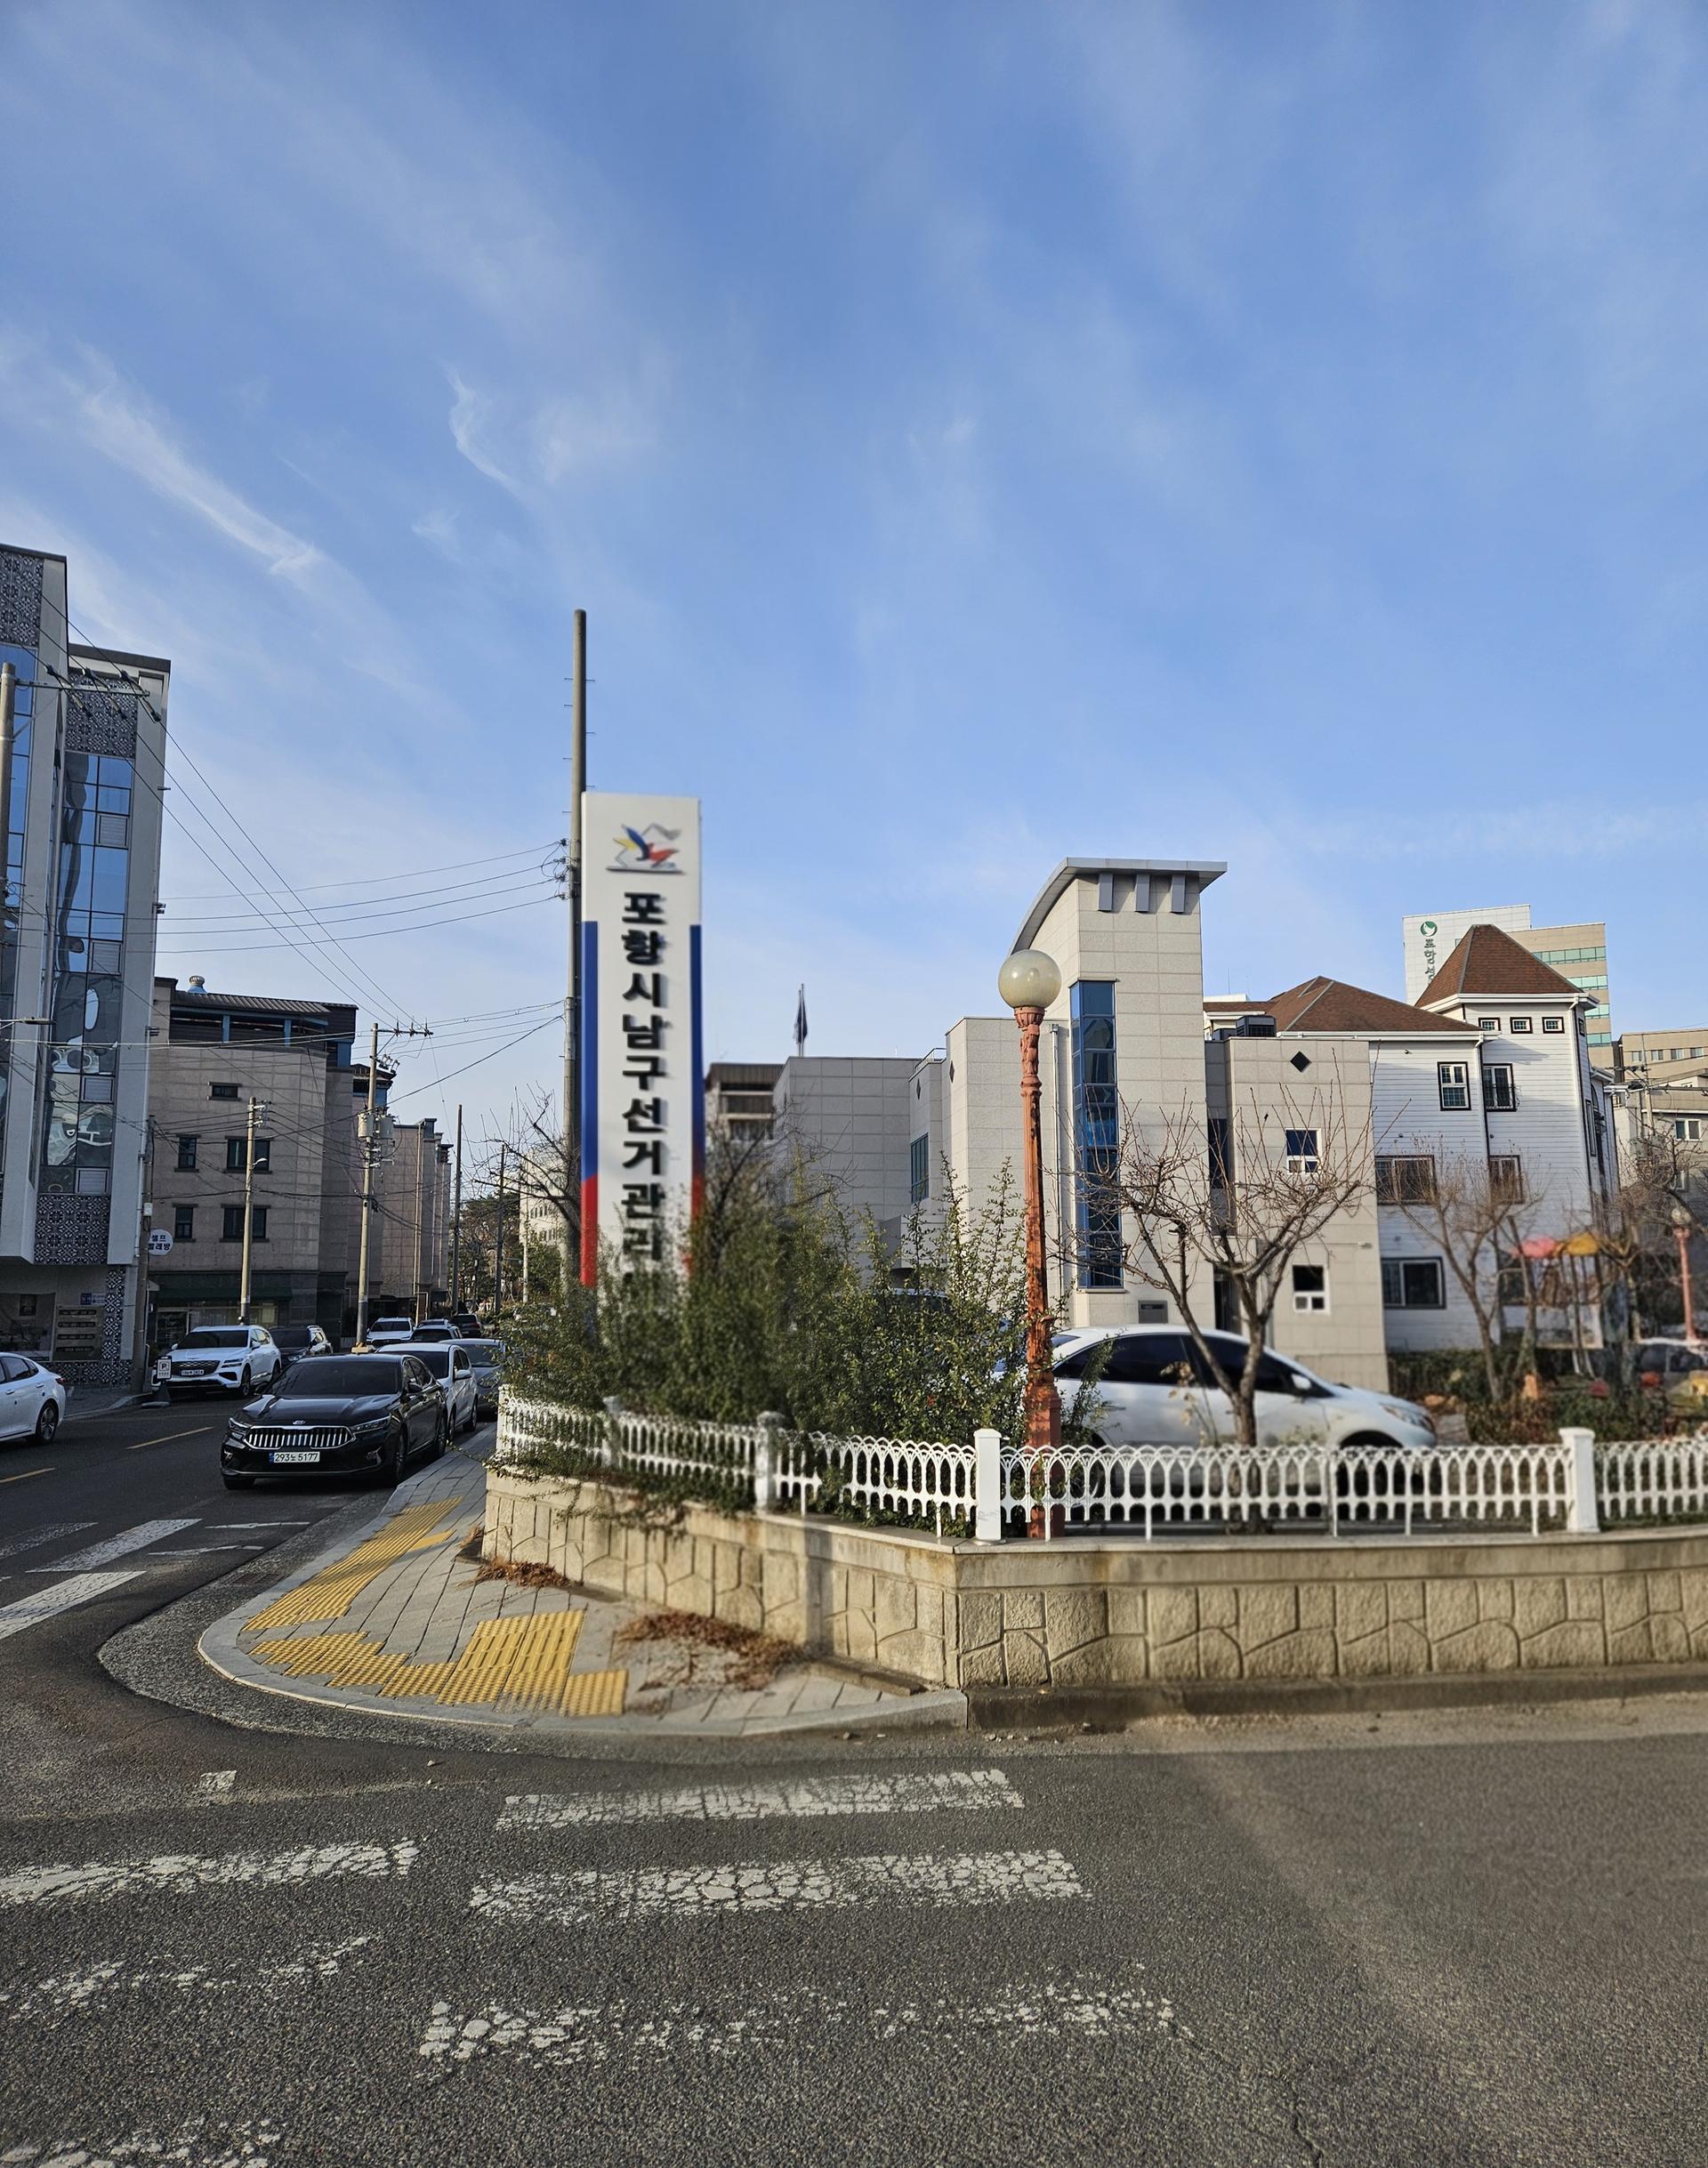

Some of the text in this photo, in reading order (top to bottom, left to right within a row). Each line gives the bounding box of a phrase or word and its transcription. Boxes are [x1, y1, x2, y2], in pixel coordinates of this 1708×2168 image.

[1424, 939, 1437, 983] 포항성
[622, 892, 667, 1285] 포항시남구선거관리
[298, 1453, 318, 1462] 5177
